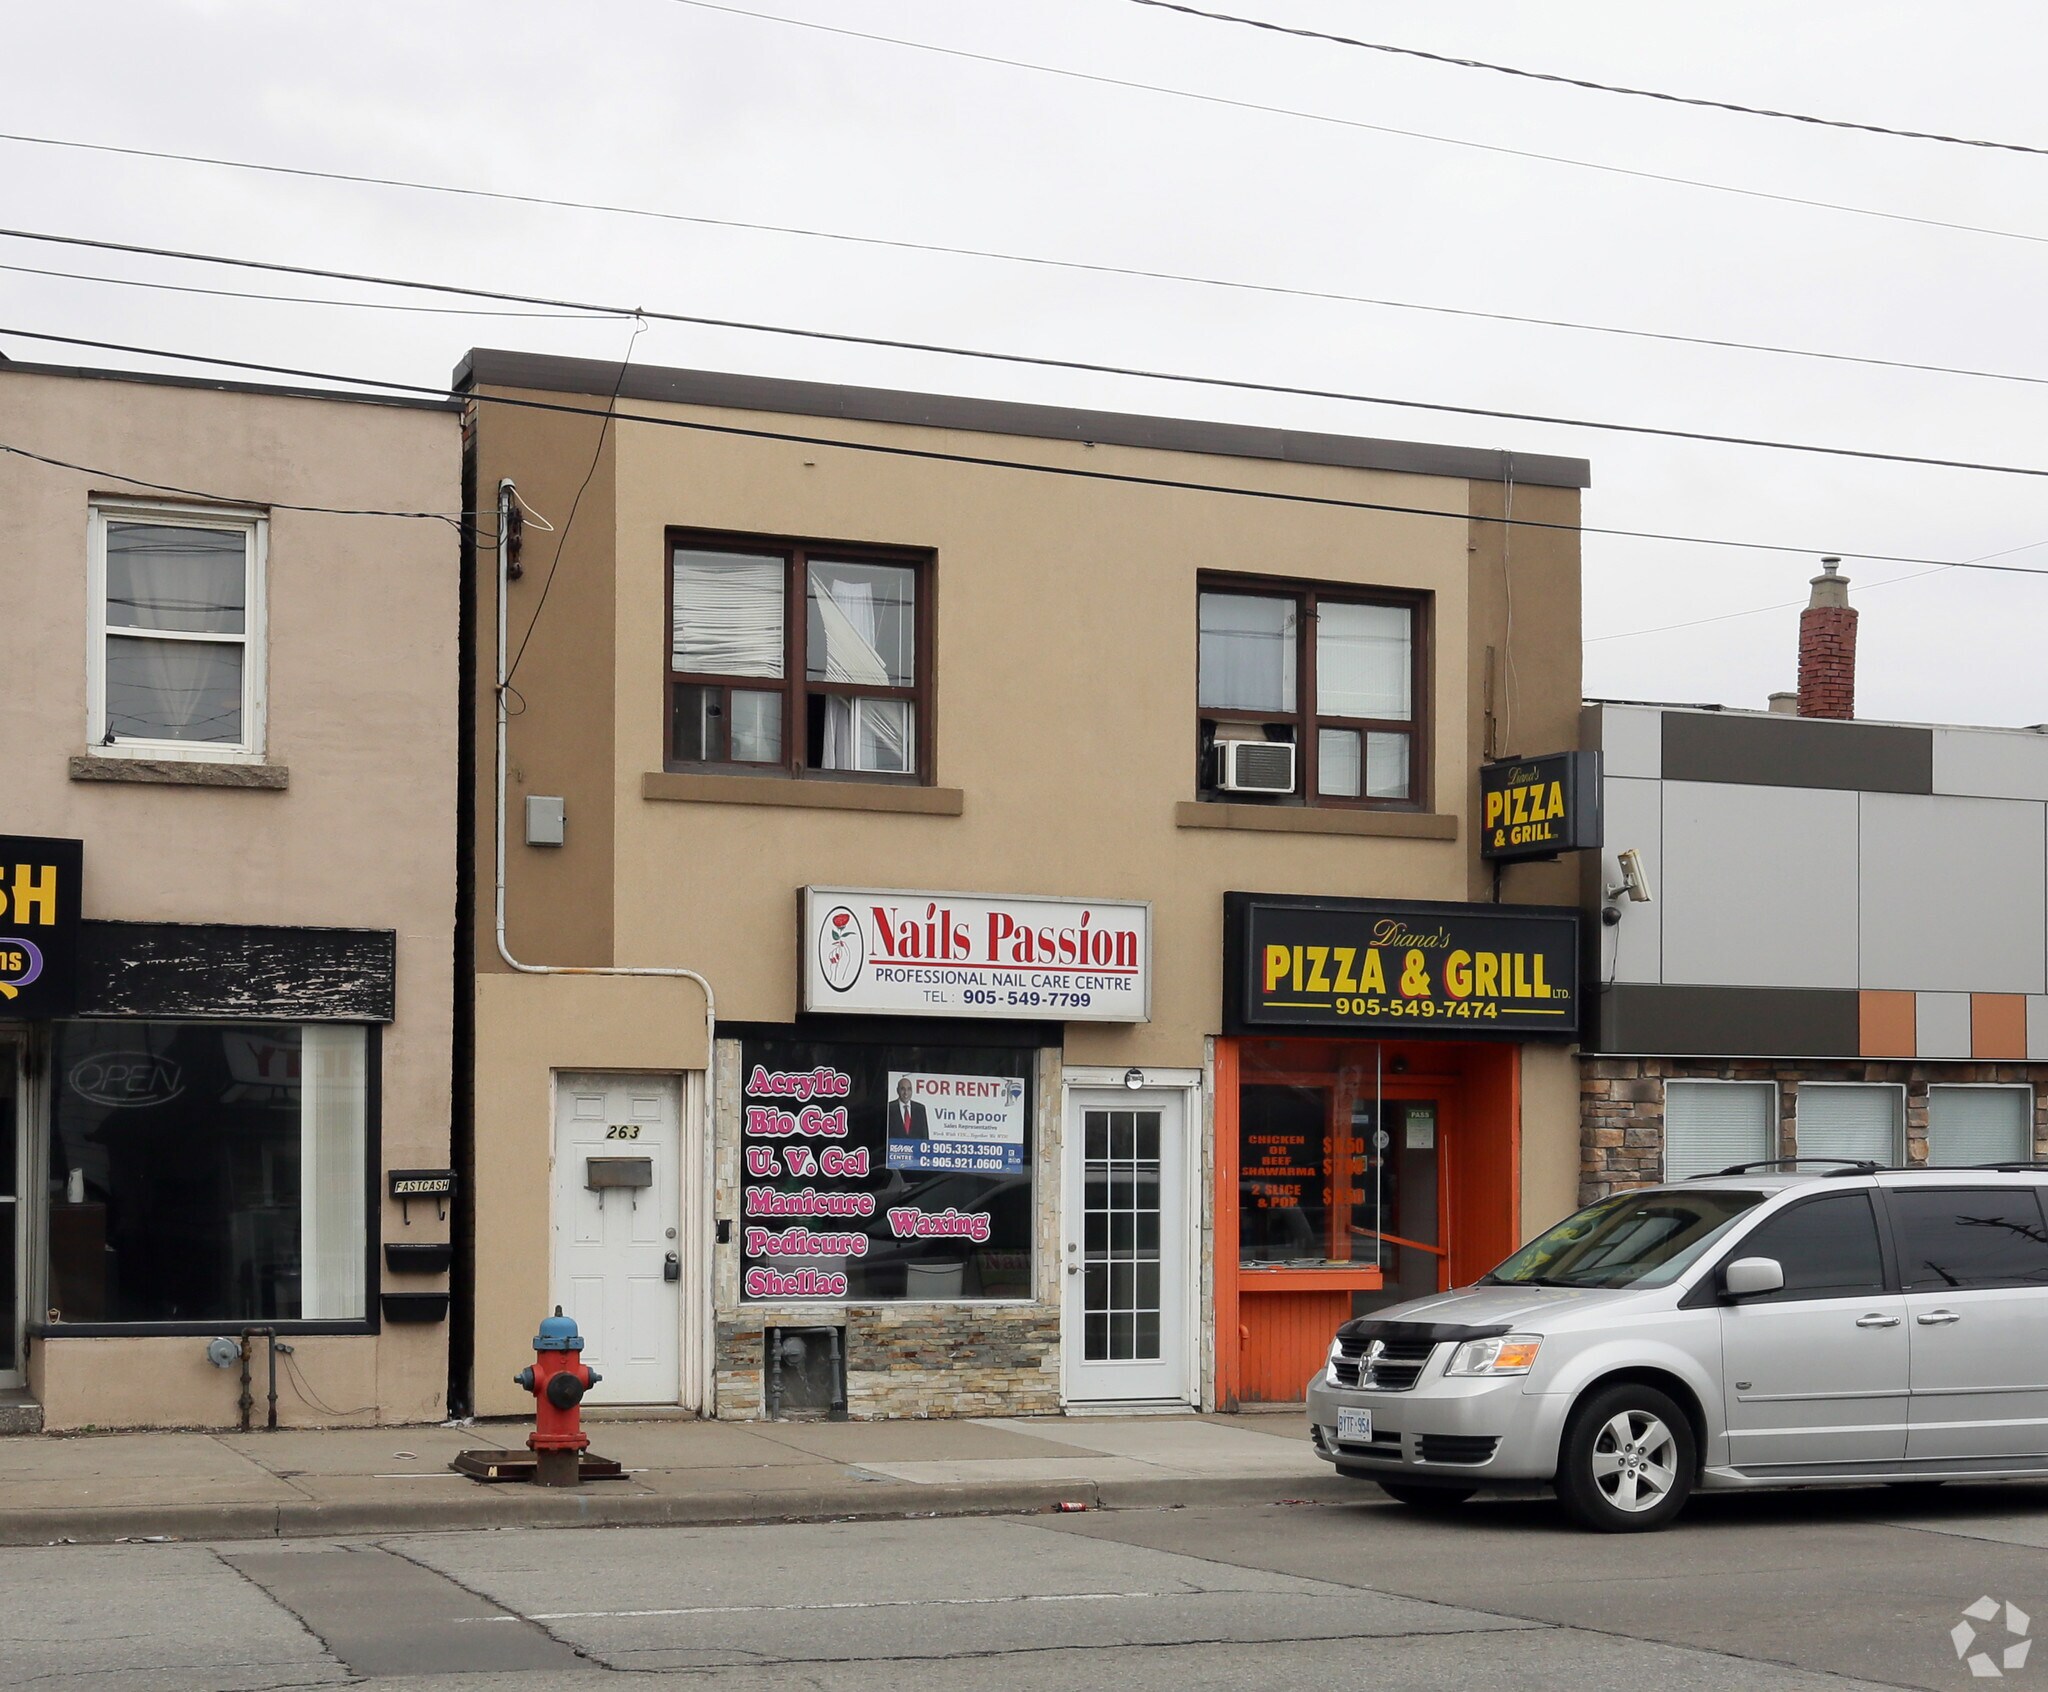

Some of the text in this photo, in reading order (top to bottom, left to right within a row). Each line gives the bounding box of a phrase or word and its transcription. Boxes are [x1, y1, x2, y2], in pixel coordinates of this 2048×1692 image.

[1486, 781, 1565, 829] PIZZA
[1494, 822, 1552, 847] & GRILL
[869, 902, 1139, 967] Nails Passion
[1369, 919, 1451, 948] Diana's
[876, 968, 1132, 991] PROFESSIONAL NAIL CARE CENTRE
[1263, 945, 1571, 999] PIZZA & GRILL LTD.
[963, 989, 1091, 1007] 905-549-7799
[1335, 998, 1498, 1019] 905-549-7474
[76, 1064, 182, 1092] OPEN
[747, 1066, 850, 1100] Acrylic
[916, 1079, 1001, 1098] FOR RENT
[747, 1106, 847, 1137] Bio Gel
[935, 1108, 1008, 1124] Vin Kapoor
[1410, 1111, 1430, 1119] PASS
[606, 1125, 640, 1139] 263
[958, 1123, 998, 1131] Representative
[932, 1143, 1003, 1156] 905.333.3500
[1248, 1135, 1305, 1145] CHICKEN
[1269, 1146, 1287, 1155] OR
[820, 1146, 869, 1177] Gel
[932, 1157, 1003, 1169] 905.921.0600
[1262, 1156, 1291, 1165] BEEF
[1242, 1167, 1316, 1176] SHAWARMA
[1251, 1184, 1302, 1195] 2 SLICE
[746, 1187, 875, 1217] Manicure
[1257, 1196, 1298, 1208] & POP
[888, 1208, 990, 1241] Waxing
[746, 1226, 868, 1256] Pedicure
[746, 1267, 847, 1297] Shellac
